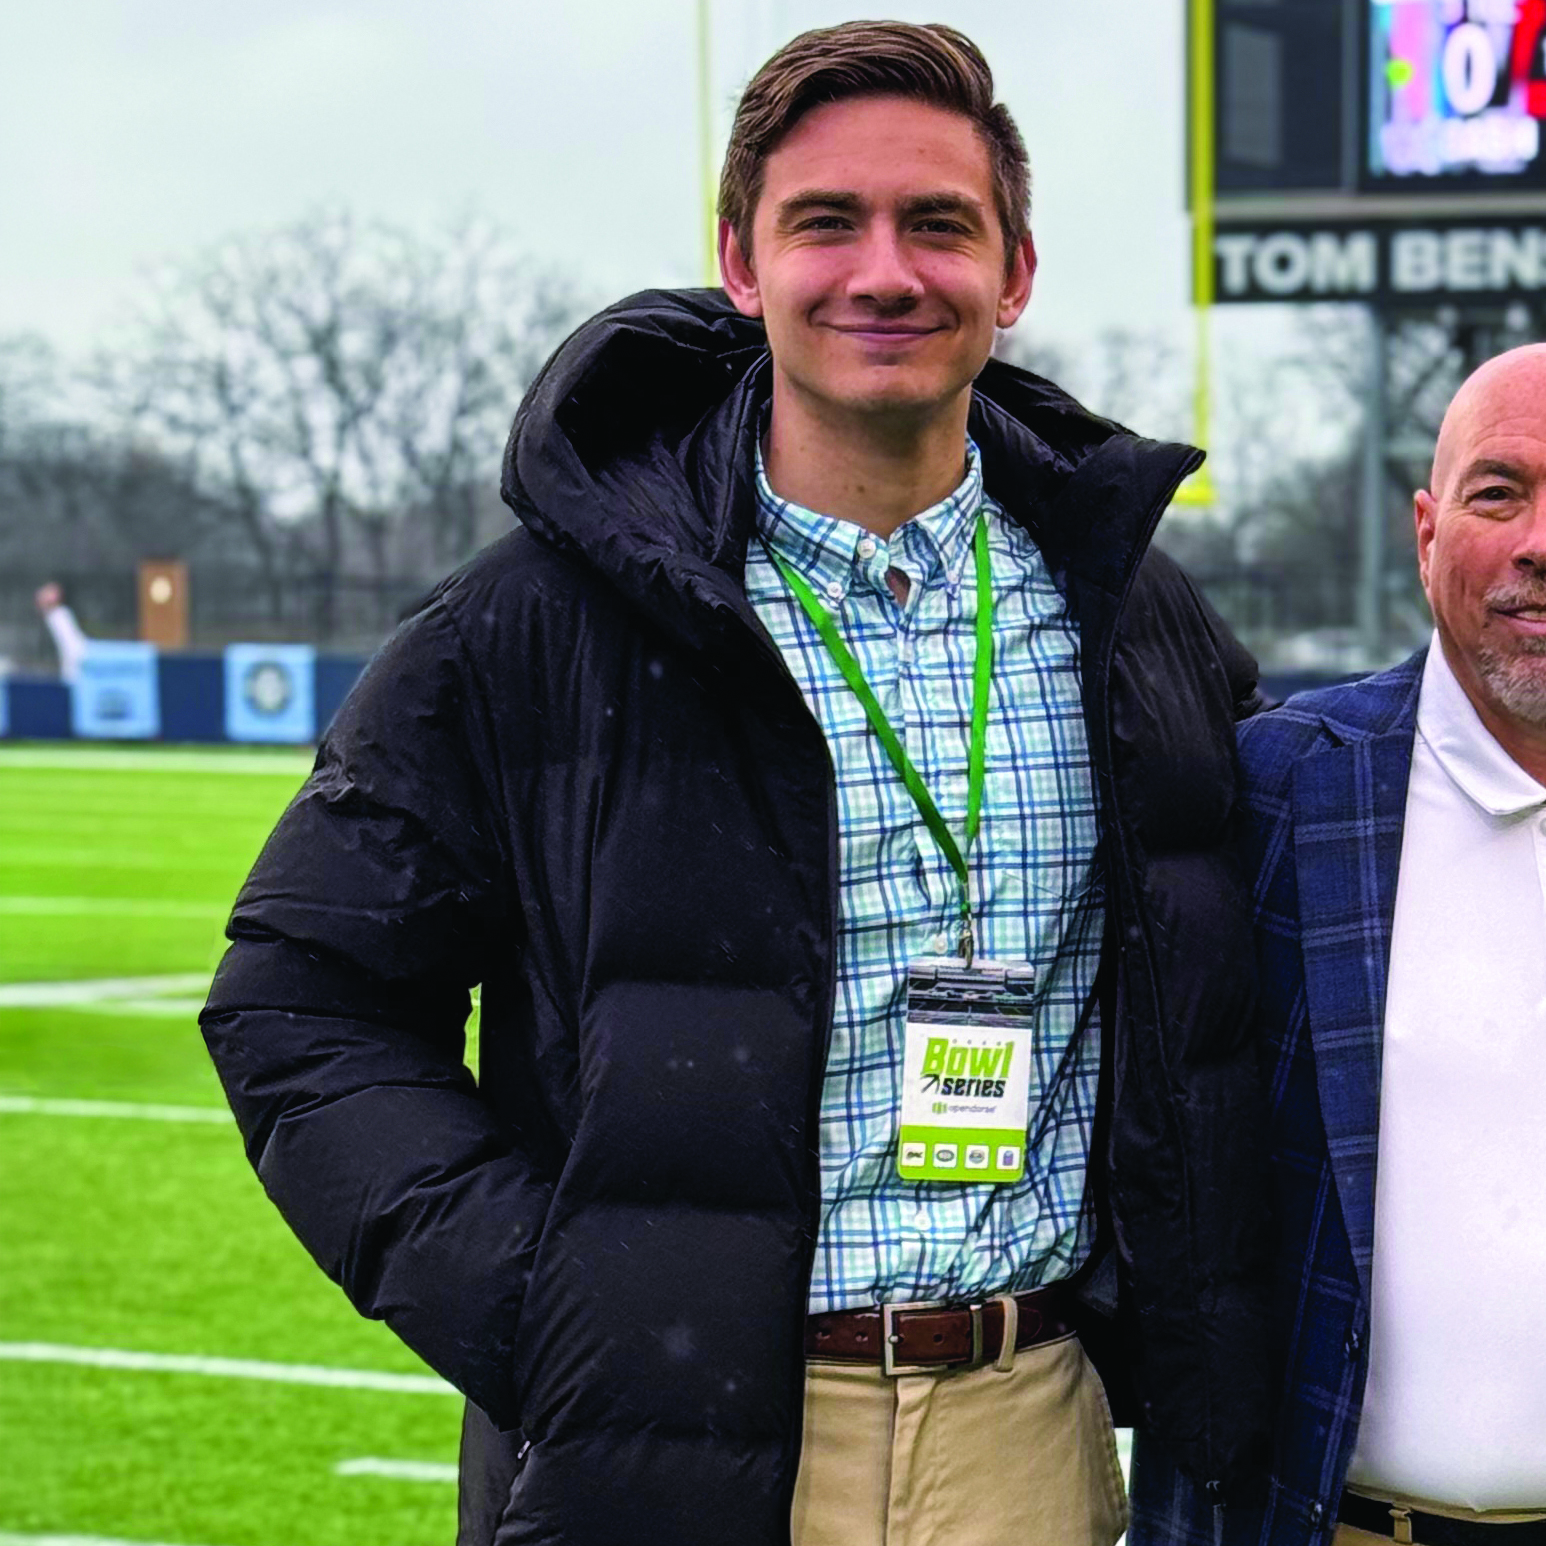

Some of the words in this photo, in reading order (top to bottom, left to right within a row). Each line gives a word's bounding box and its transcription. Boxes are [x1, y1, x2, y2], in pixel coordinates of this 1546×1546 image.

[1443, 22, 1496, 116] 0
[1216, 230, 1376, 294] TOM
[921, 1037, 1015, 1078] Bowl
[941, 1077, 1006, 1098] series
